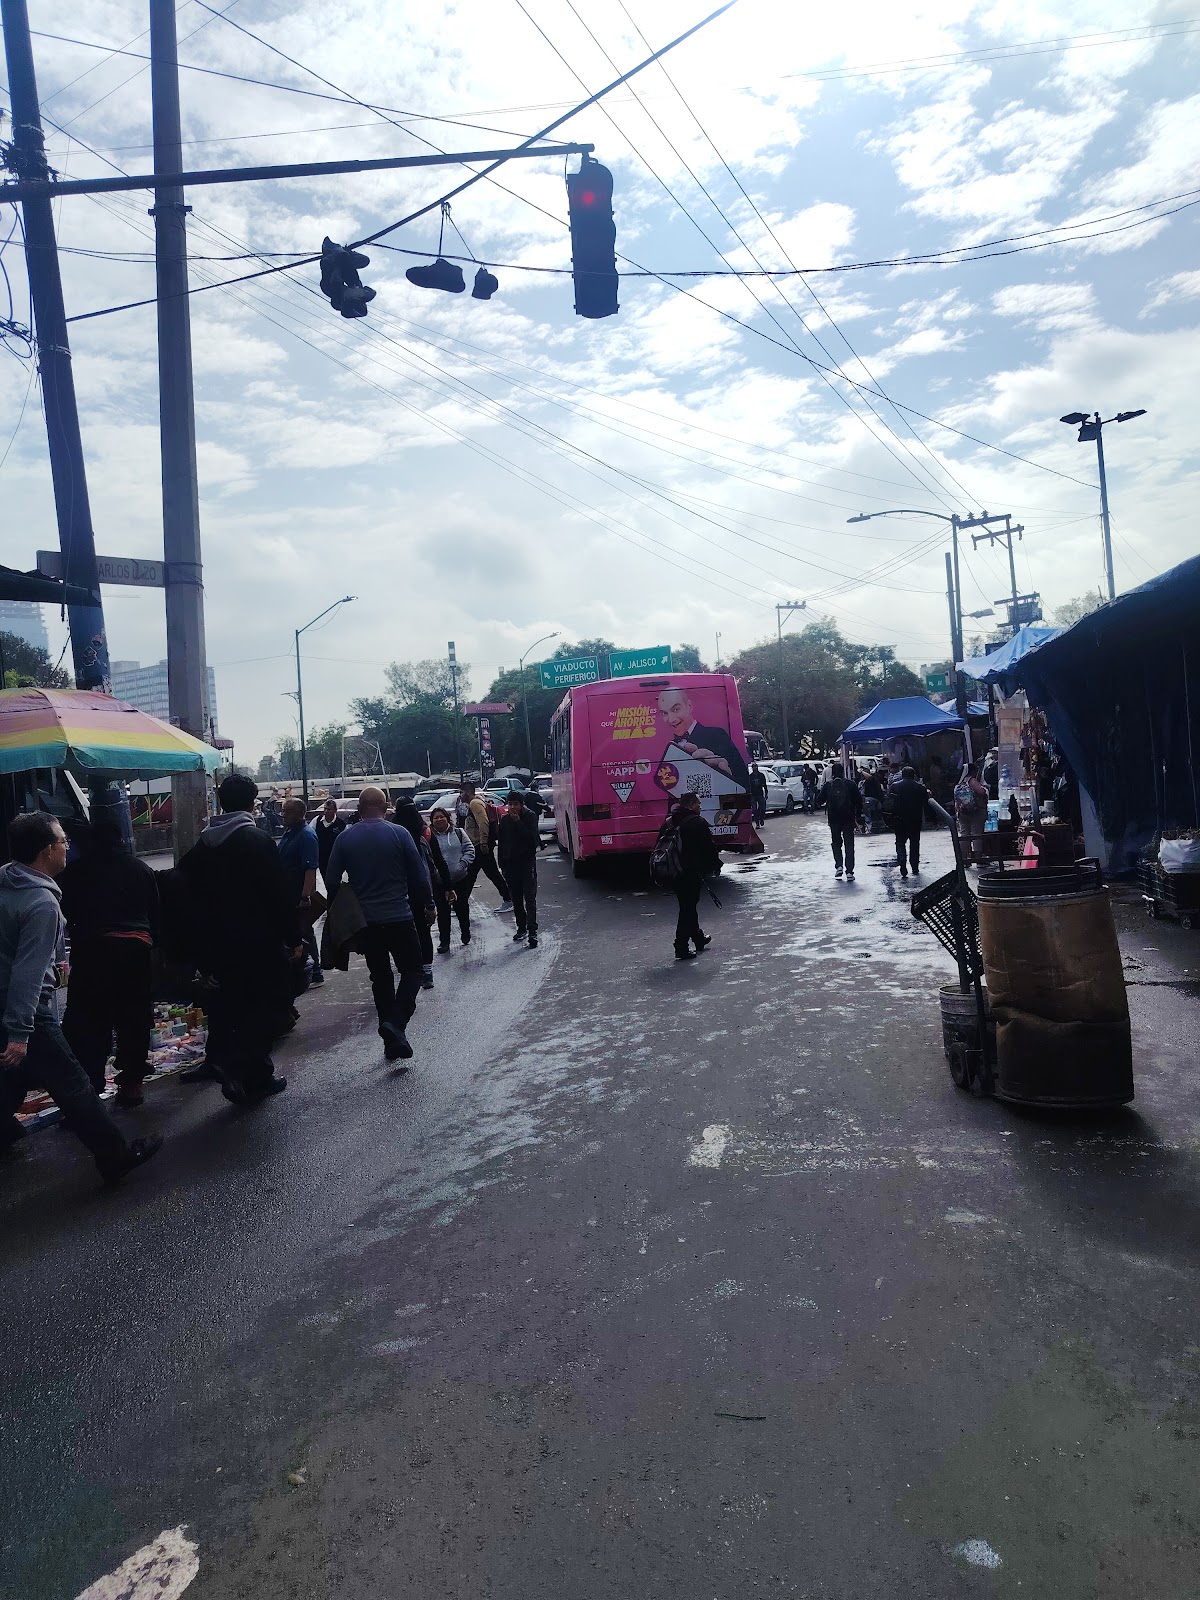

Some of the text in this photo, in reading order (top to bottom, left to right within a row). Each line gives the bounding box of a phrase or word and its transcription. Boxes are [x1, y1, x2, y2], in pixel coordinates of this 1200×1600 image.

[97, 562, 130, 579] ARLOS
[553, 659, 595, 673] VIADUCTO
[613, 657, 657, 671] AV. JALISCO
[554, 671, 597, 684] PERIFERICO
[616, 704, 650, 718] MISIÓN
[614, 715, 656, 728] AHORRES
[612, 726, 657, 740] MÁS
[614, 766, 635, 776] APP
